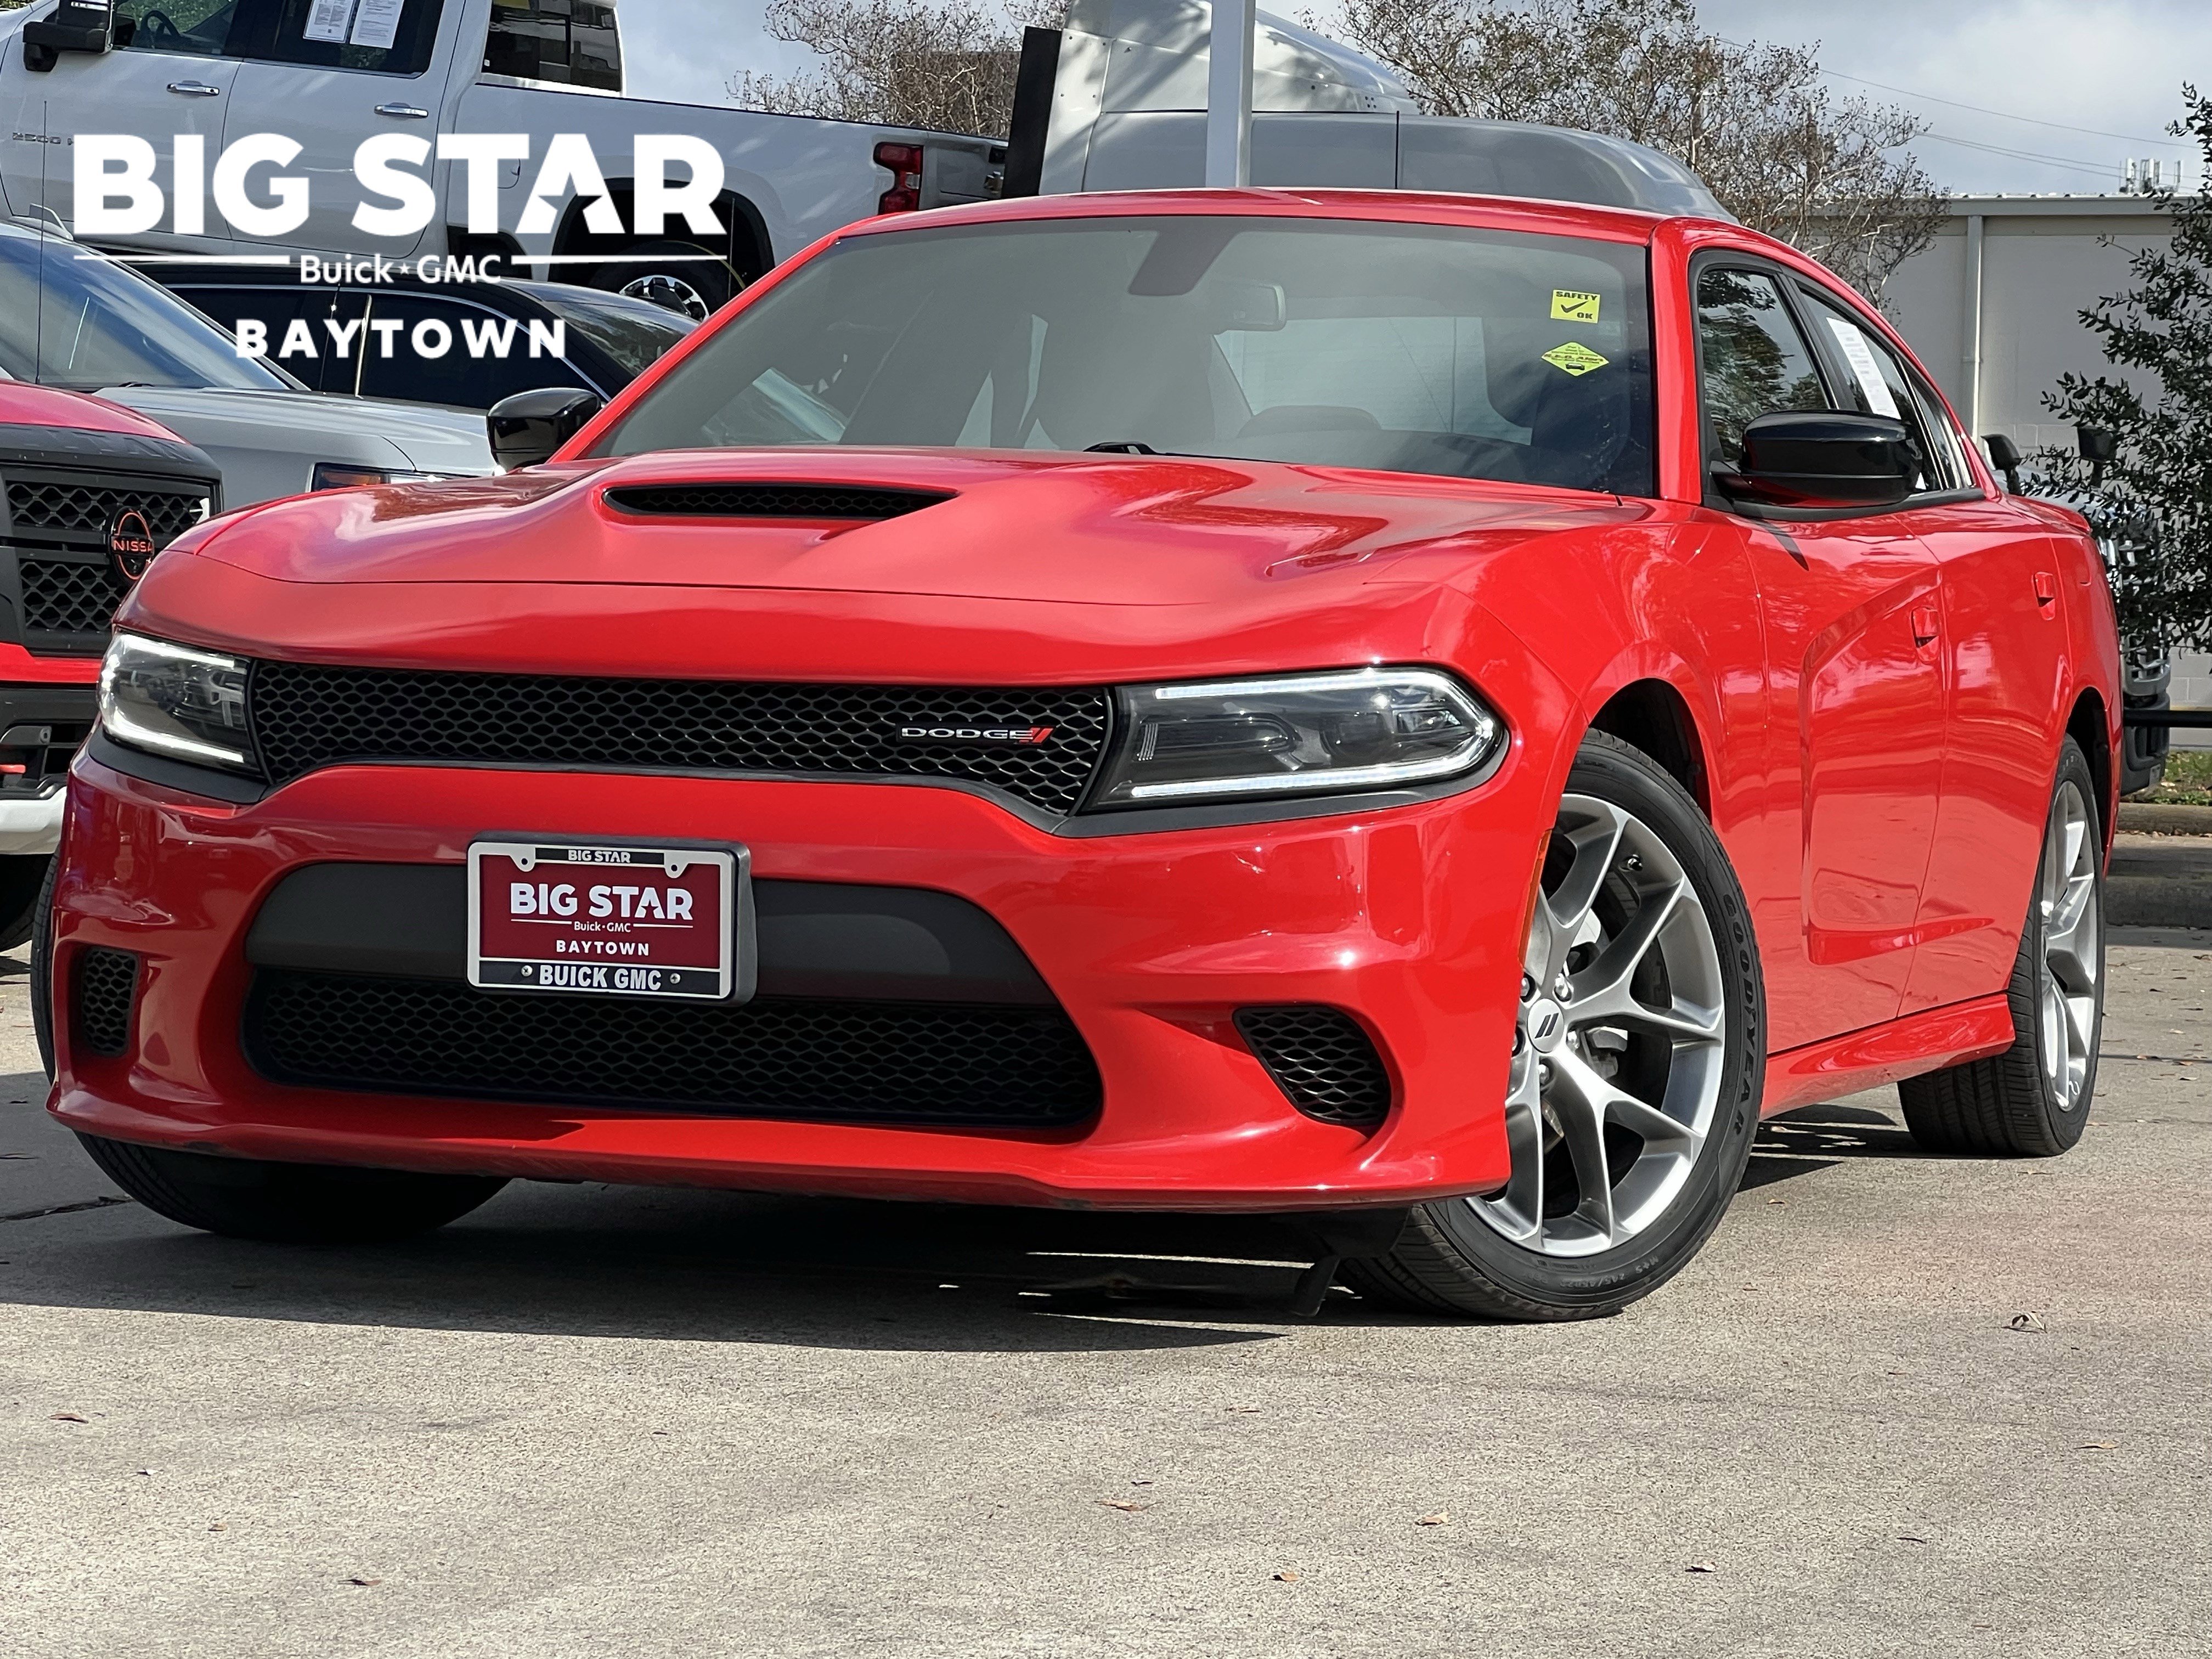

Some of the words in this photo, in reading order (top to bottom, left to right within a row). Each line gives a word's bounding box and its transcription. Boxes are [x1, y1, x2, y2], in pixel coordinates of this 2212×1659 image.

[1556, 291, 1598, 301] SAFETY
[114, 539, 153, 552] NISSA
[901, 727, 1034, 740] DODGE
[568, 850, 592, 862] BIG
[594, 851, 631, 864] STAR
[510, 882, 578, 916] BIG
[589, 885, 693, 921] STAR
[574, 921, 601, 932] Buick
[606, 922, 631, 933] GMC
[556, 939, 649, 956] BAYTOWN
[539, 964, 608, 988] BUICK
[614, 968, 662, 991] GMC
[1723, 894, 1756, 1136] GOODYEAR
